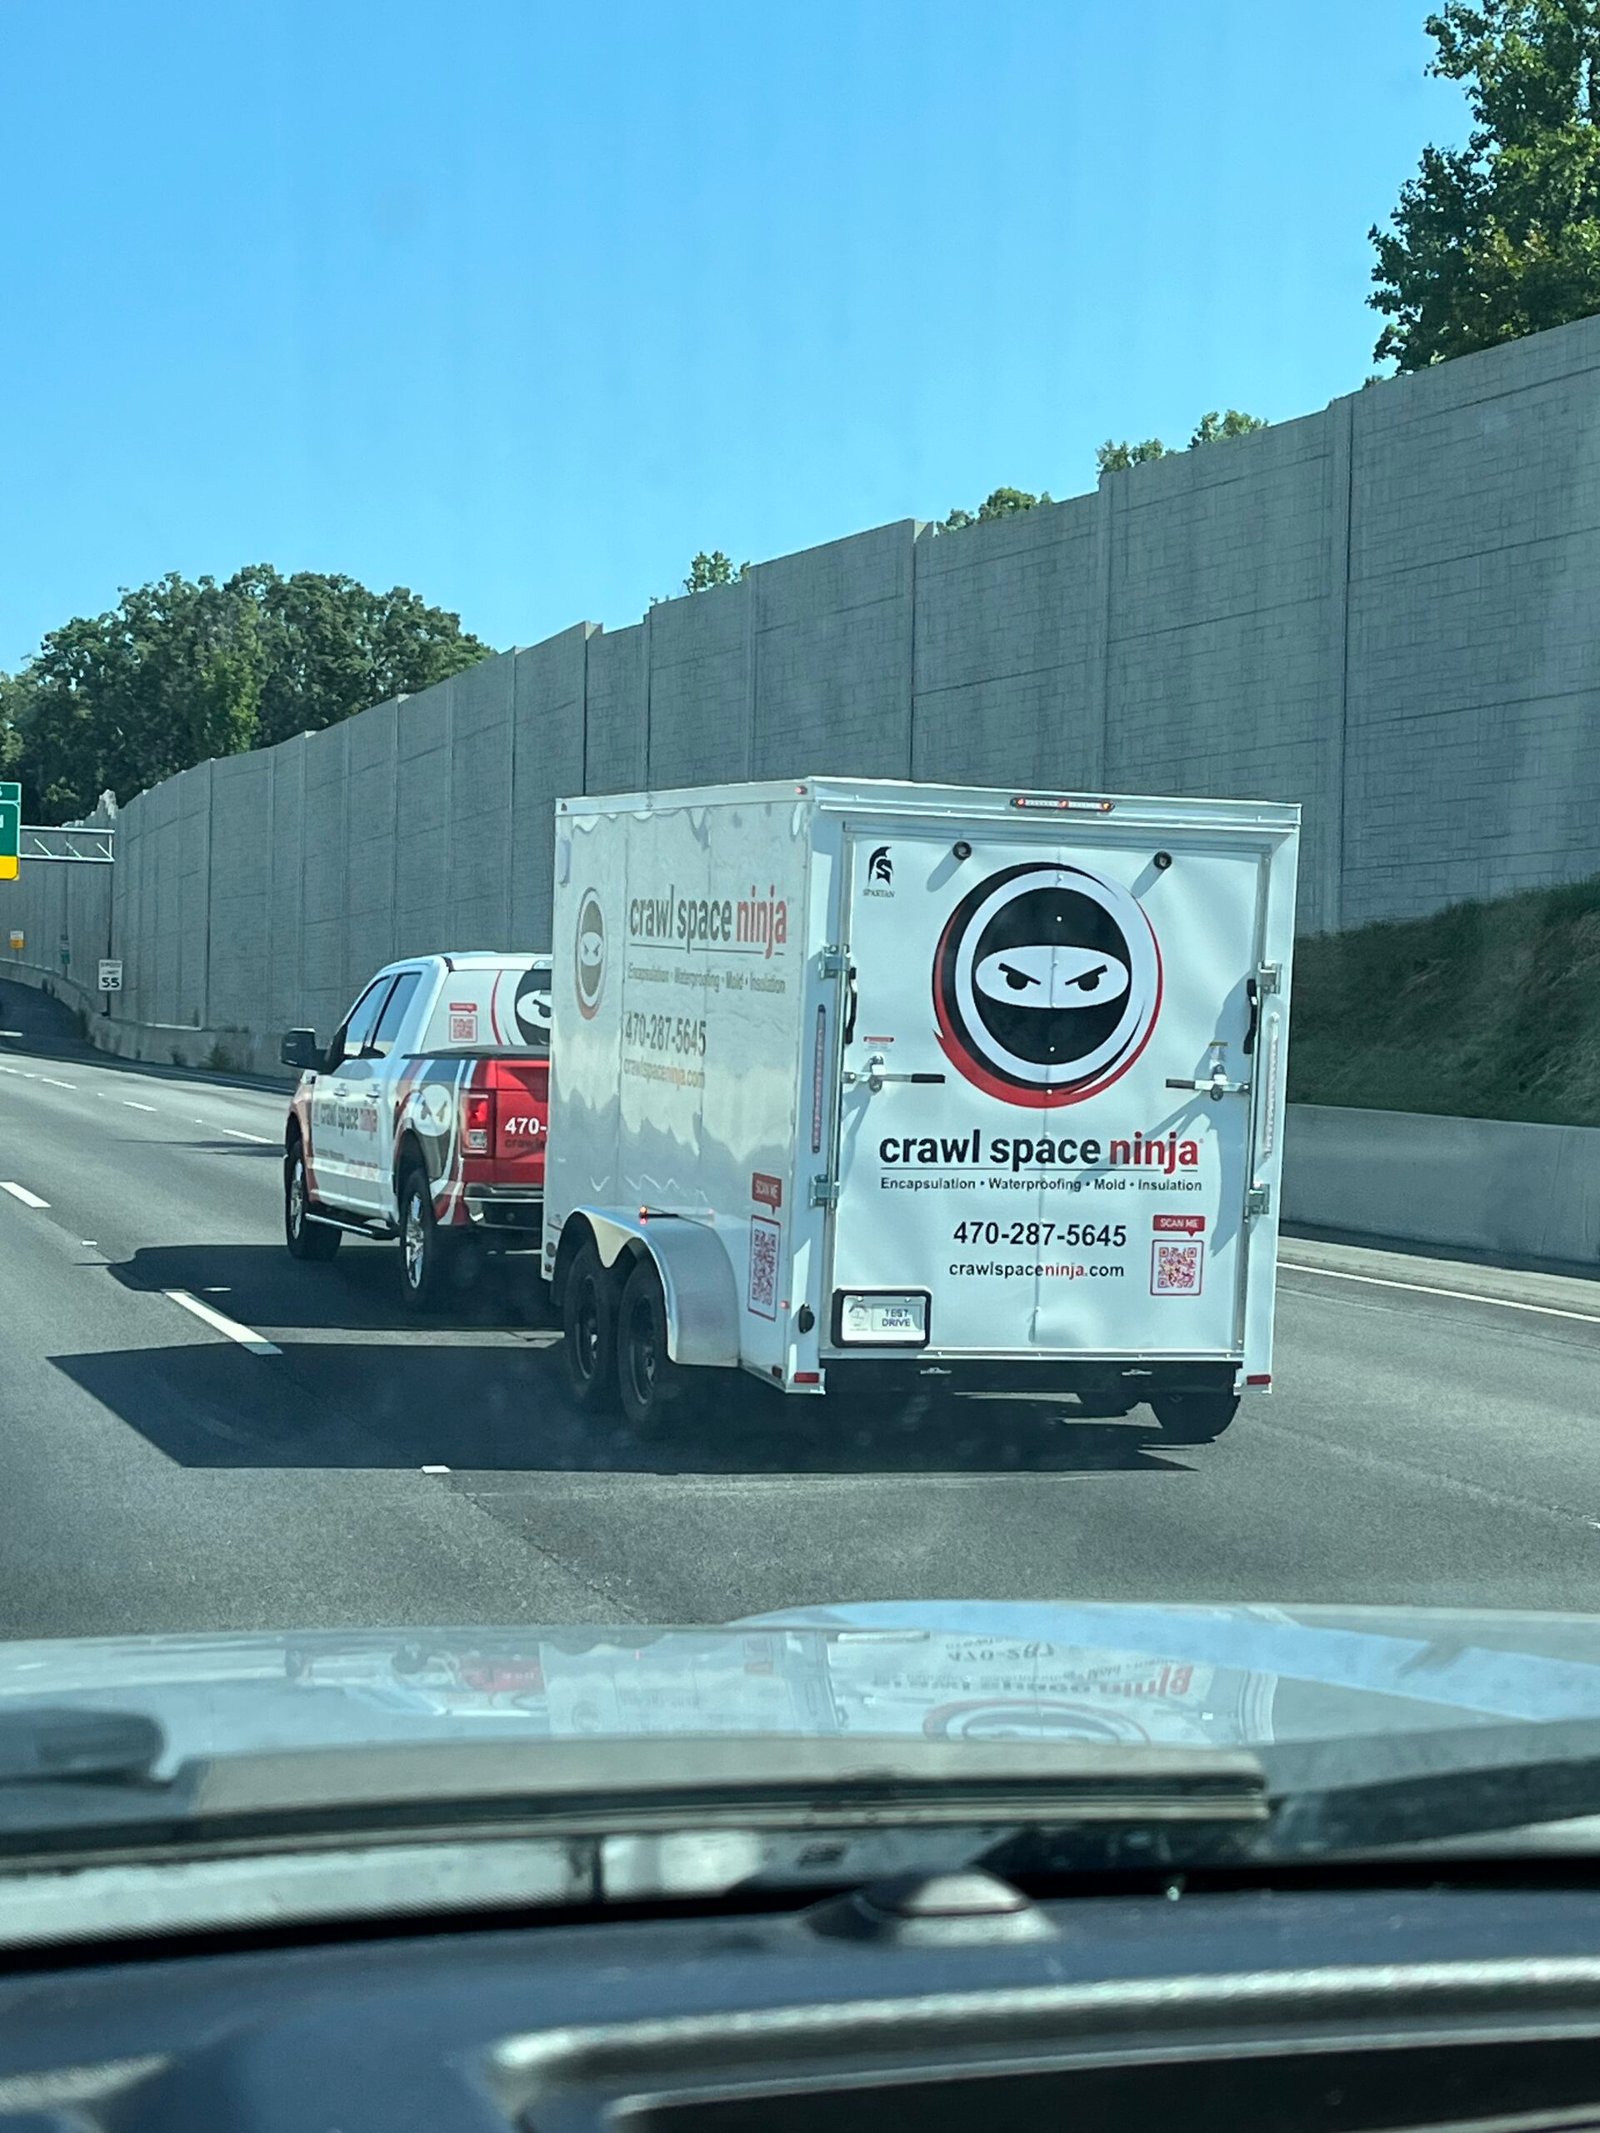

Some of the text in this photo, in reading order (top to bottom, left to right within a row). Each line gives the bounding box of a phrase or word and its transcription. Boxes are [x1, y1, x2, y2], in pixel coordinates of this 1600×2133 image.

[630, 884, 787, 960] crawl space ninja
[101, 976, 120, 988] 55
[625, 1011, 707, 1057] 470-287-5645
[505, 1117, 547, 1135] 470-
[879, 1129, 1198, 1174] crawl space ninja
[880, 1177, 1203, 1193] Encapsulation Waterproofing Mold Insulation
[1160, 1217, 1184, 1228] SCAN
[953, 1221, 1127, 1247] 470-287-5645
[949, 1261, 1125, 1280] crawlspaceninja.com
[884, 1308, 909, 1318] TEST
[881, 1318, 911, 1328] DRIVE
